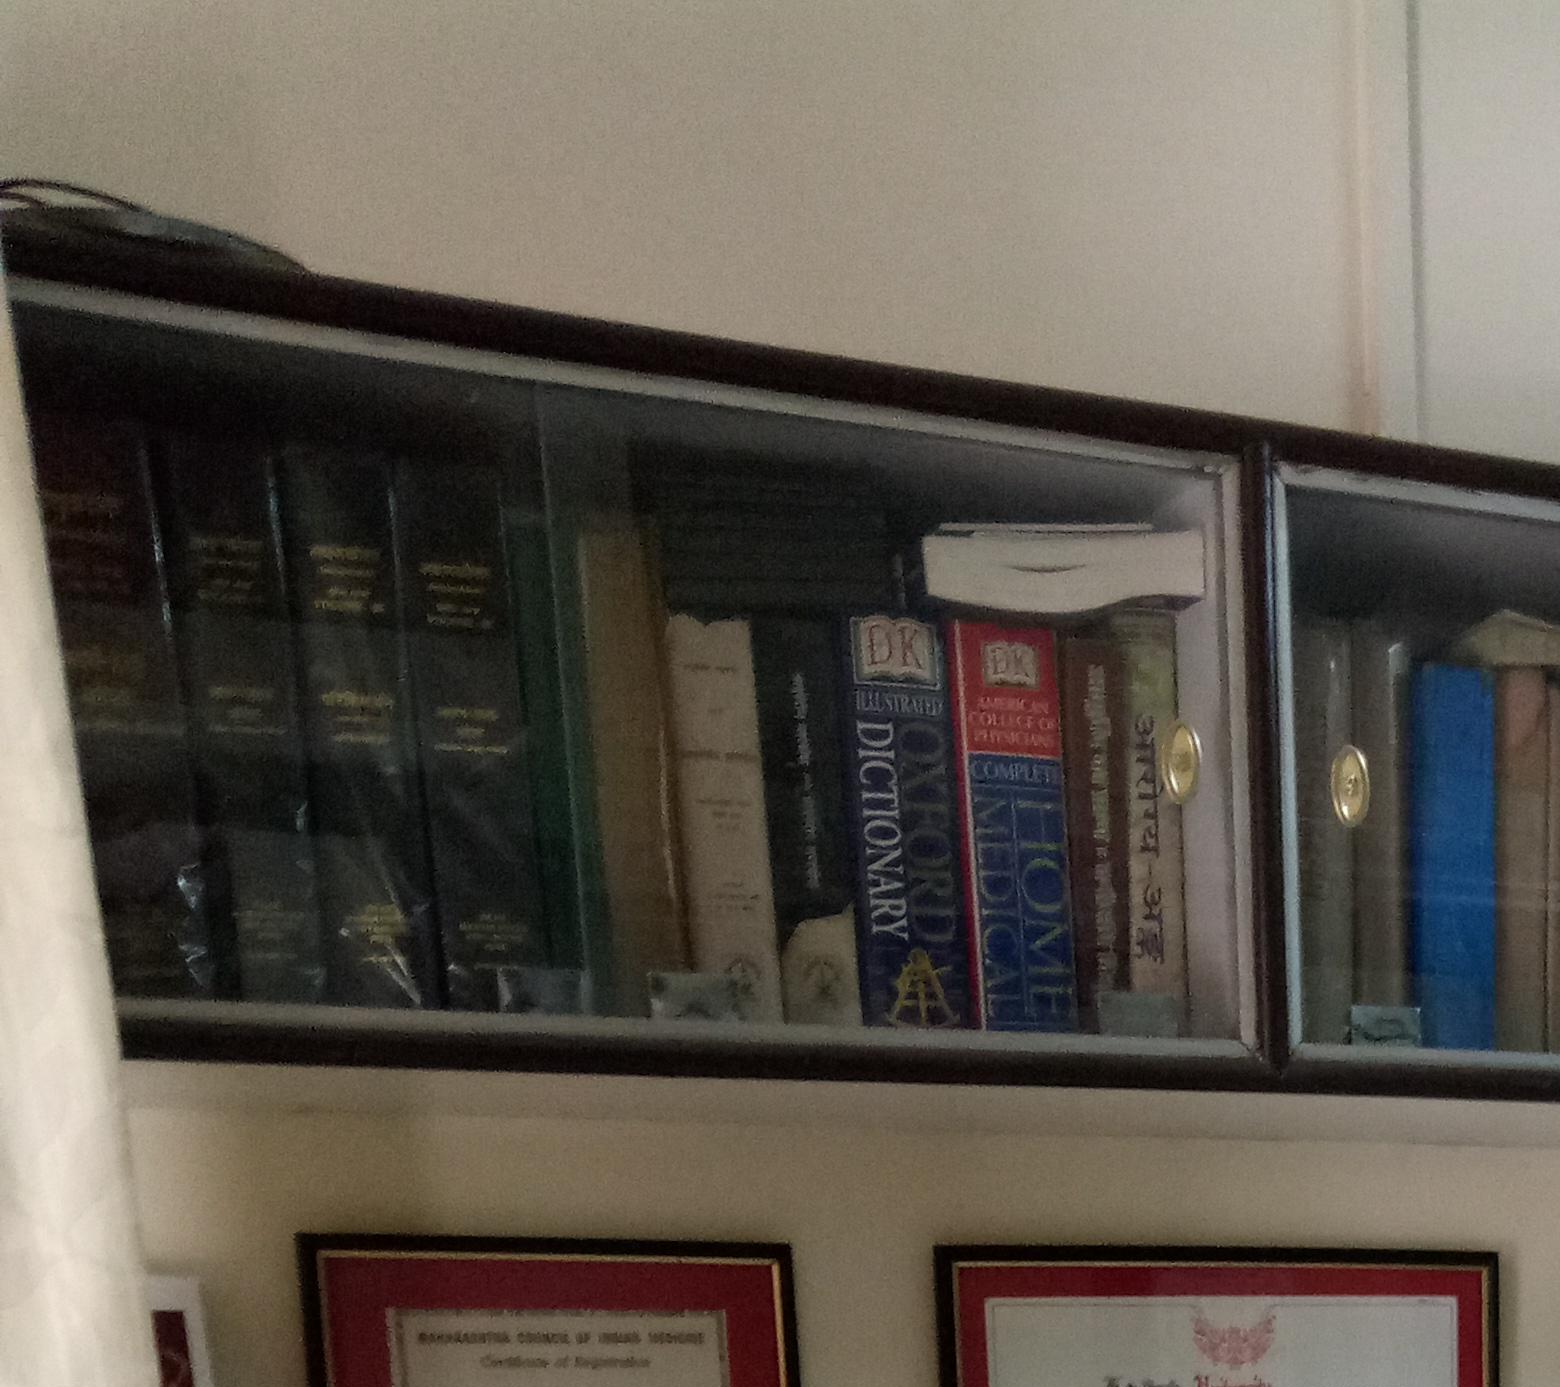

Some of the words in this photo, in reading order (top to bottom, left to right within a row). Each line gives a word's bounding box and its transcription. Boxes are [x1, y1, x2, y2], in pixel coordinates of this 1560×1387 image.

[867, 623, 923, 670] DK
[989, 645, 1032, 678] DK
[855, 689, 944, 716] ILLUSTRATED
[968, 711, 1035, 730] COLLEGE
[977, 696, 1050, 715] AMERICAN
[856, 718, 909, 942] DICTIONARY
[900, 721, 957, 943] OXFORD
[973, 796, 1022, 1018] MEDICAL
[1017, 800, 1074, 1018] HOME
